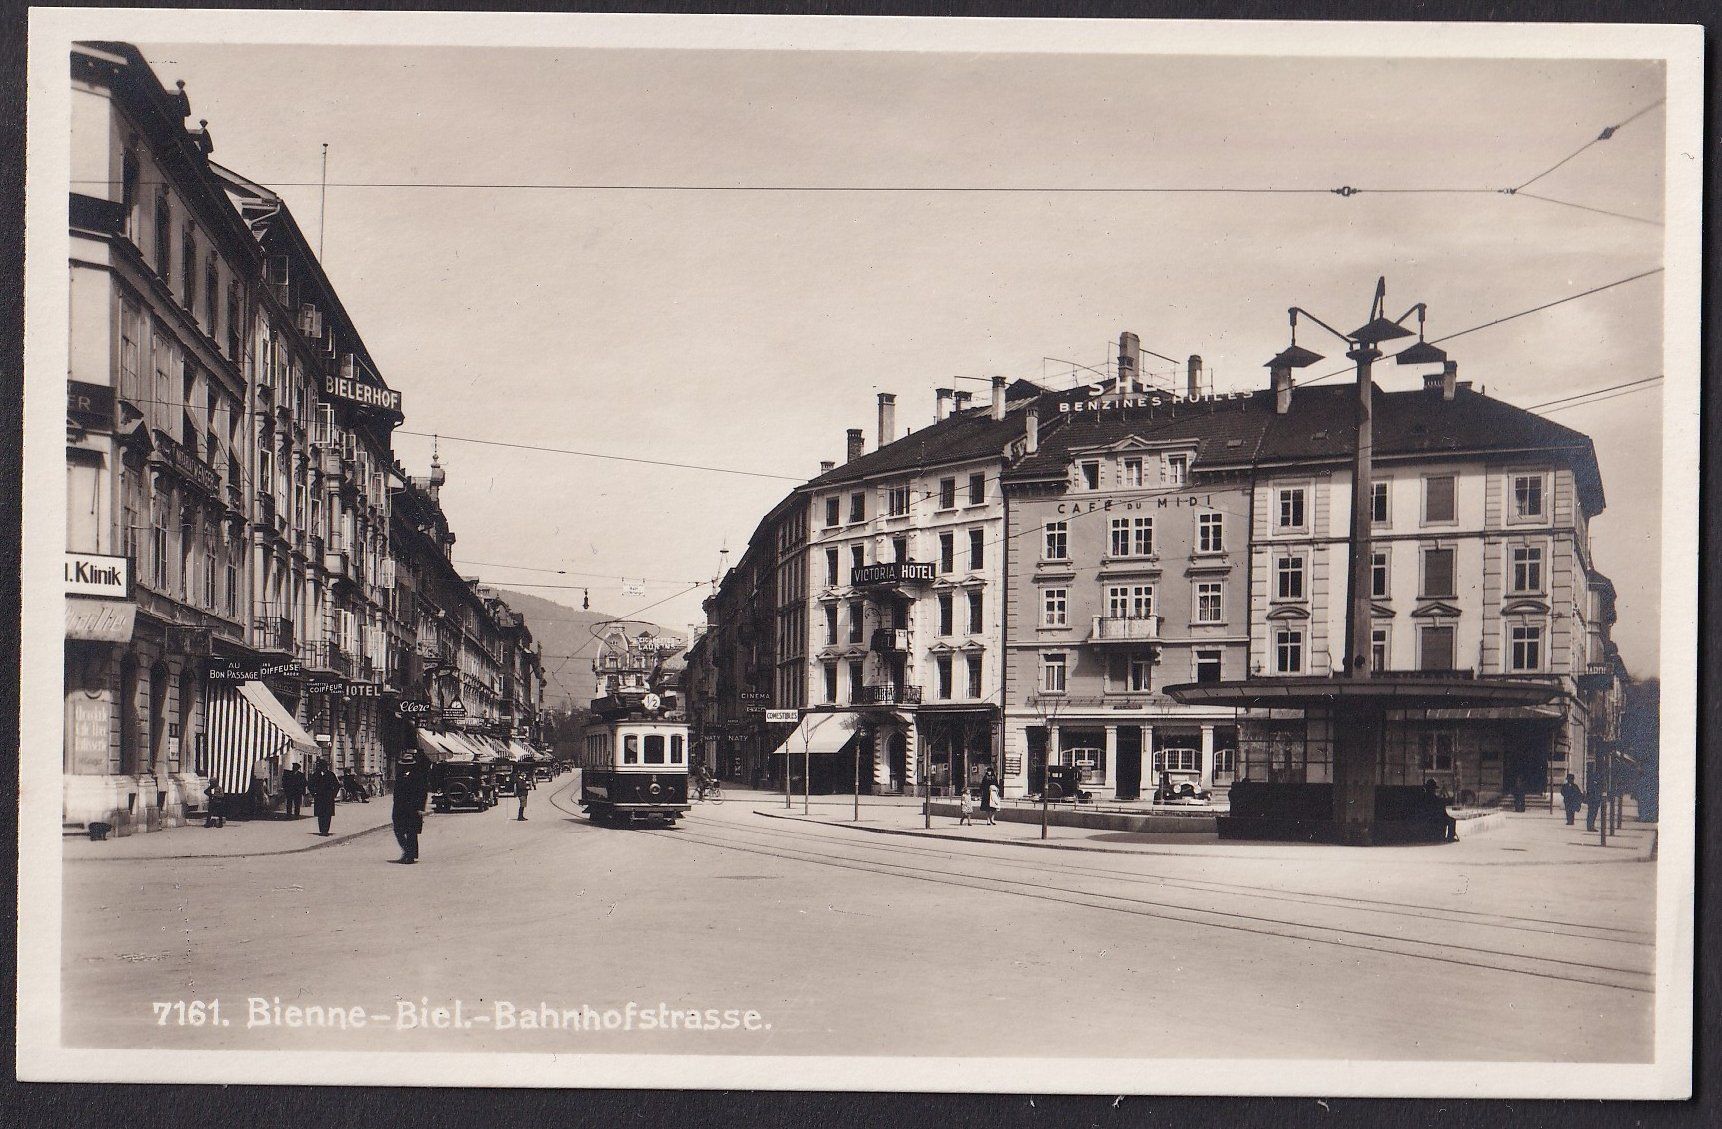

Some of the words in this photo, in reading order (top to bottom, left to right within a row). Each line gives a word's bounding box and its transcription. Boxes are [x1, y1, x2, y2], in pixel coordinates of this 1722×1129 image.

[326, 376, 398, 409] BIELERHOF
[1059, 397, 1162, 413] BENZINES
[1172, 391, 1254, 405] HUILES
[1127, 502, 1142, 510] DU
[1157, 494, 1212, 509] MIDI
[854, 566, 896, 582] VICTORIA
[902, 565, 934, 579] HOTEL
[261, 664, 300, 675] OIFFEUSE
[309, 683, 343, 693] COIFFEUR
[400, 701, 430, 712] Clerc
